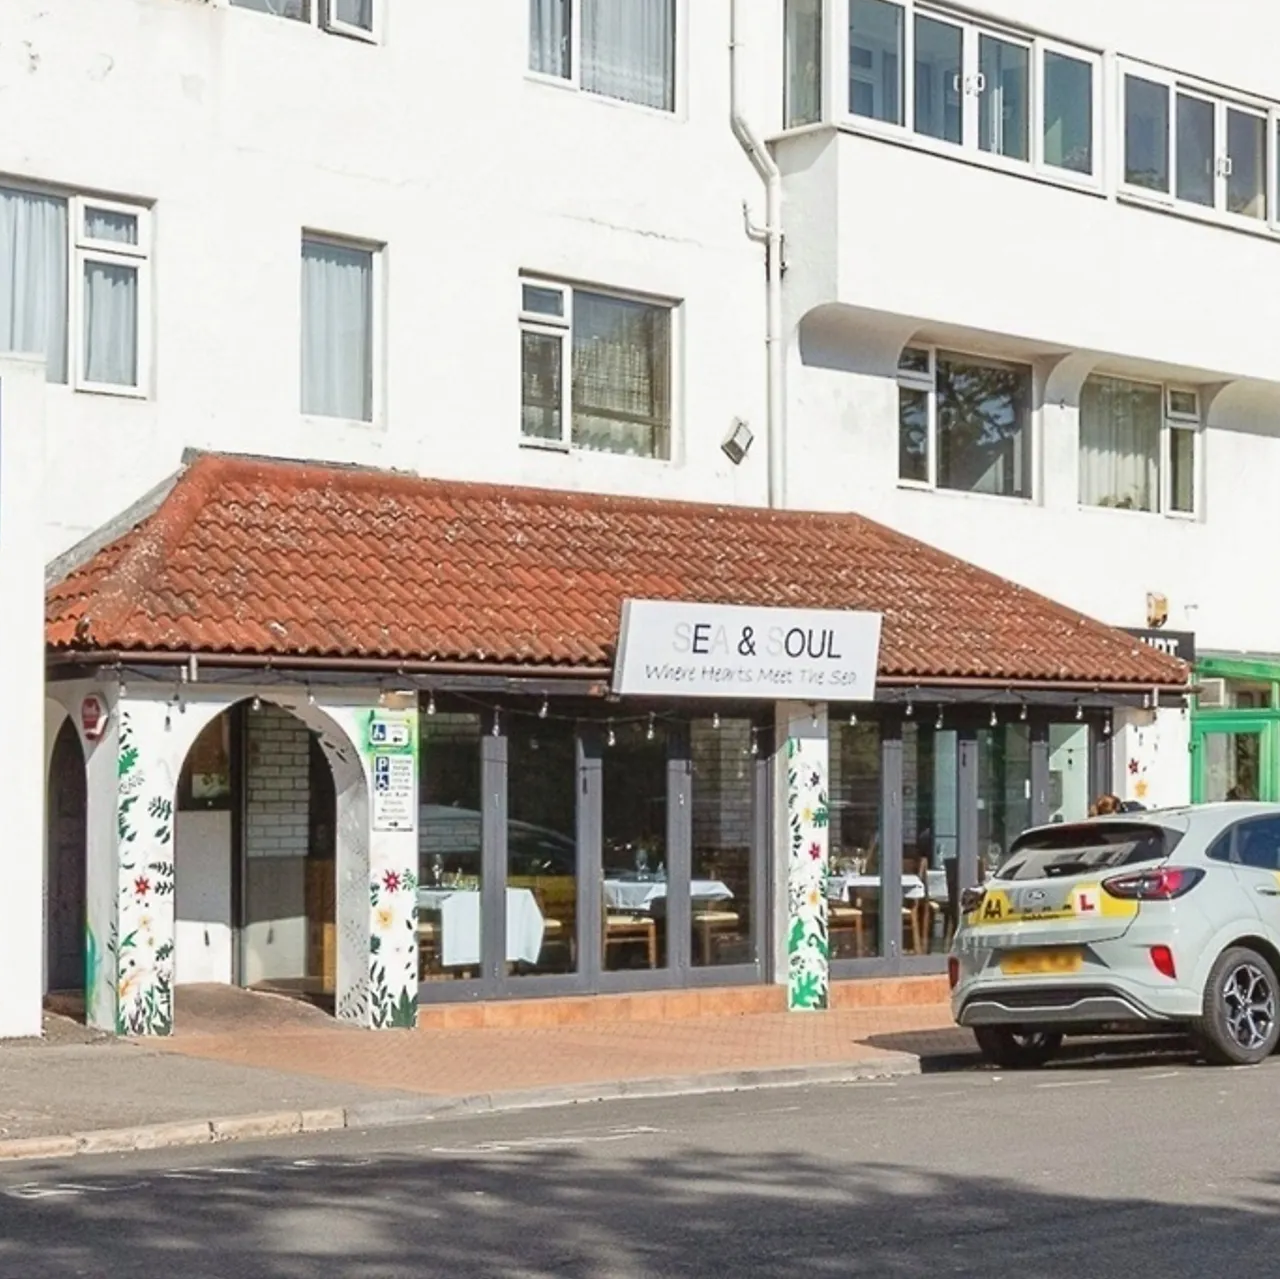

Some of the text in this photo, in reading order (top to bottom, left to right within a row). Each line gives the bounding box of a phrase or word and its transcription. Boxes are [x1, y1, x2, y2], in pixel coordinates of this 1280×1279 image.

[737, 626, 756, 656] &
[645, 664, 858, 686] Where Hearts Meet The Sea
[983, 899, 1002, 919] AA
[1080, 894, 1094, 911] L
